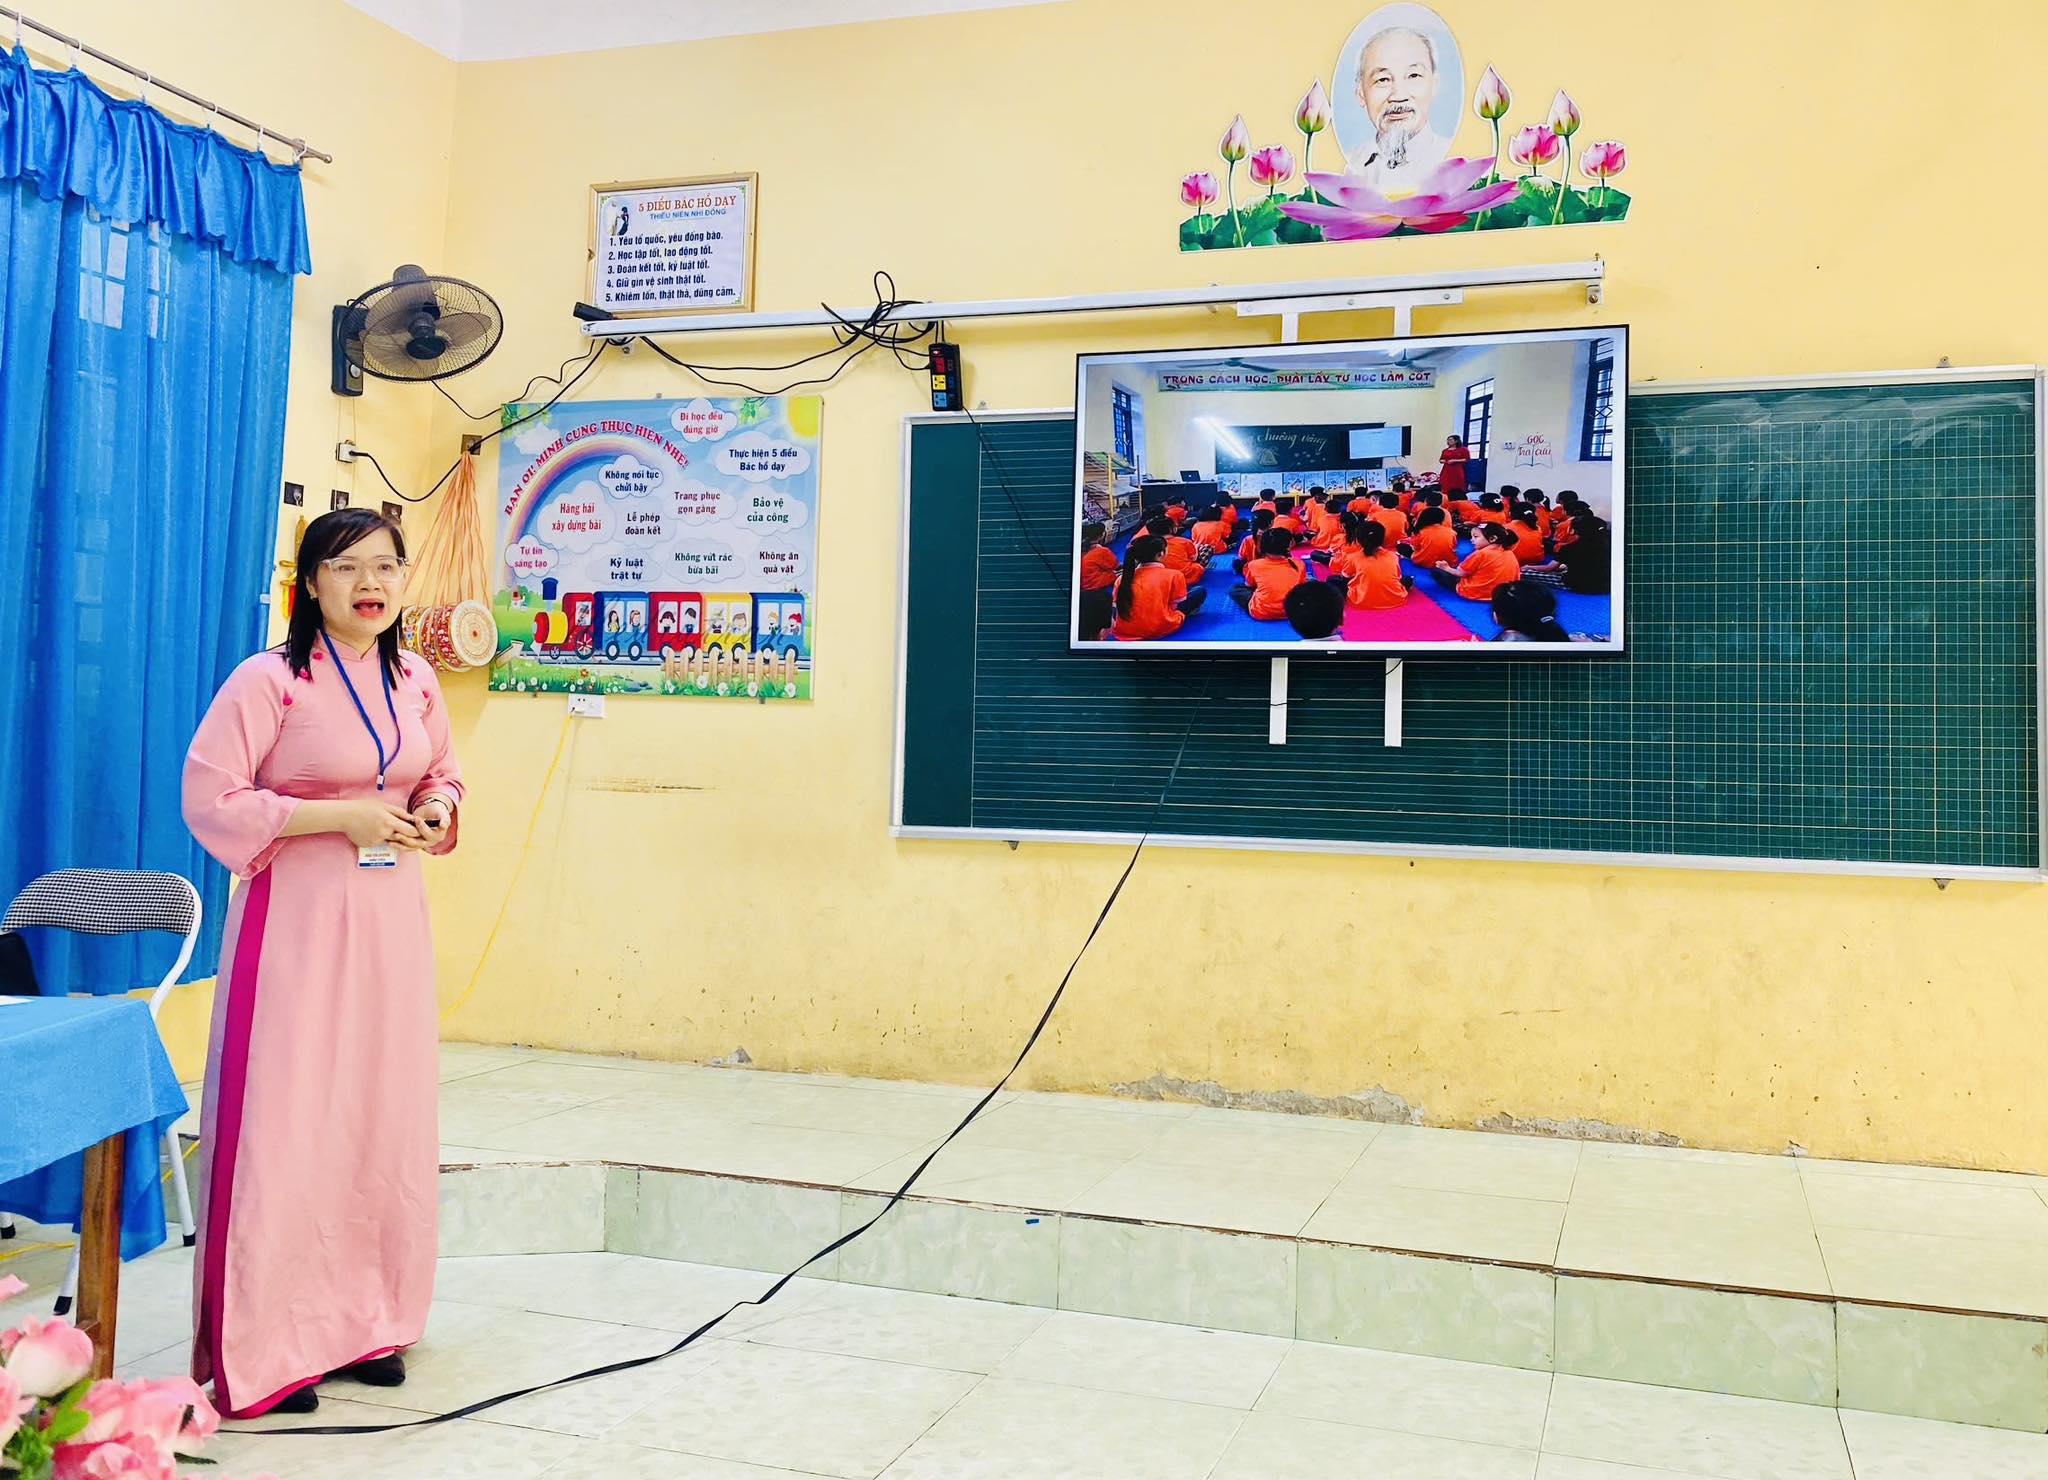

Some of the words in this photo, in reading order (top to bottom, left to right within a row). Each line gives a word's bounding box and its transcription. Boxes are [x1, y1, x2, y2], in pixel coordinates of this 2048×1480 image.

[638, 203, 644, 212] 5
[610, 238, 616, 246] 1.
[608, 252, 615, 260] 2.
[664, 248, 676, 256] lao
[608, 265, 614, 274] 3.
[606, 279, 614, 288] 4.
[657, 276, 674, 286] sinh
[606, 293, 612, 302] 5.
[680, 412, 689, 420] Đi
[729, 449, 750, 460] Thực
[752, 448, 769, 459] hiện
[772, 448, 778, 458] 5
[770, 462, 786, 472] dạy
[605, 470, 630, 480] Không
[632, 470, 644, 478] nói
[646, 470, 660, 480] tục
[674, 492, 698, 502] Trang
[700, 492, 720, 502] phục
[753, 496, 770, 508] Bảo
[773, 498, 784, 510] vệ
[678, 505, 693, 514] gọn
[640, 514, 660, 523] phép
[747, 512, 764, 522] của
[766, 513, 789, 524] công
[647, 524, 661, 536] kết
[675, 552, 700, 563] Không
[759, 552, 786, 561] Không
[534, 560, 548, 569] tạo
[626, 558, 644, 568] luật
